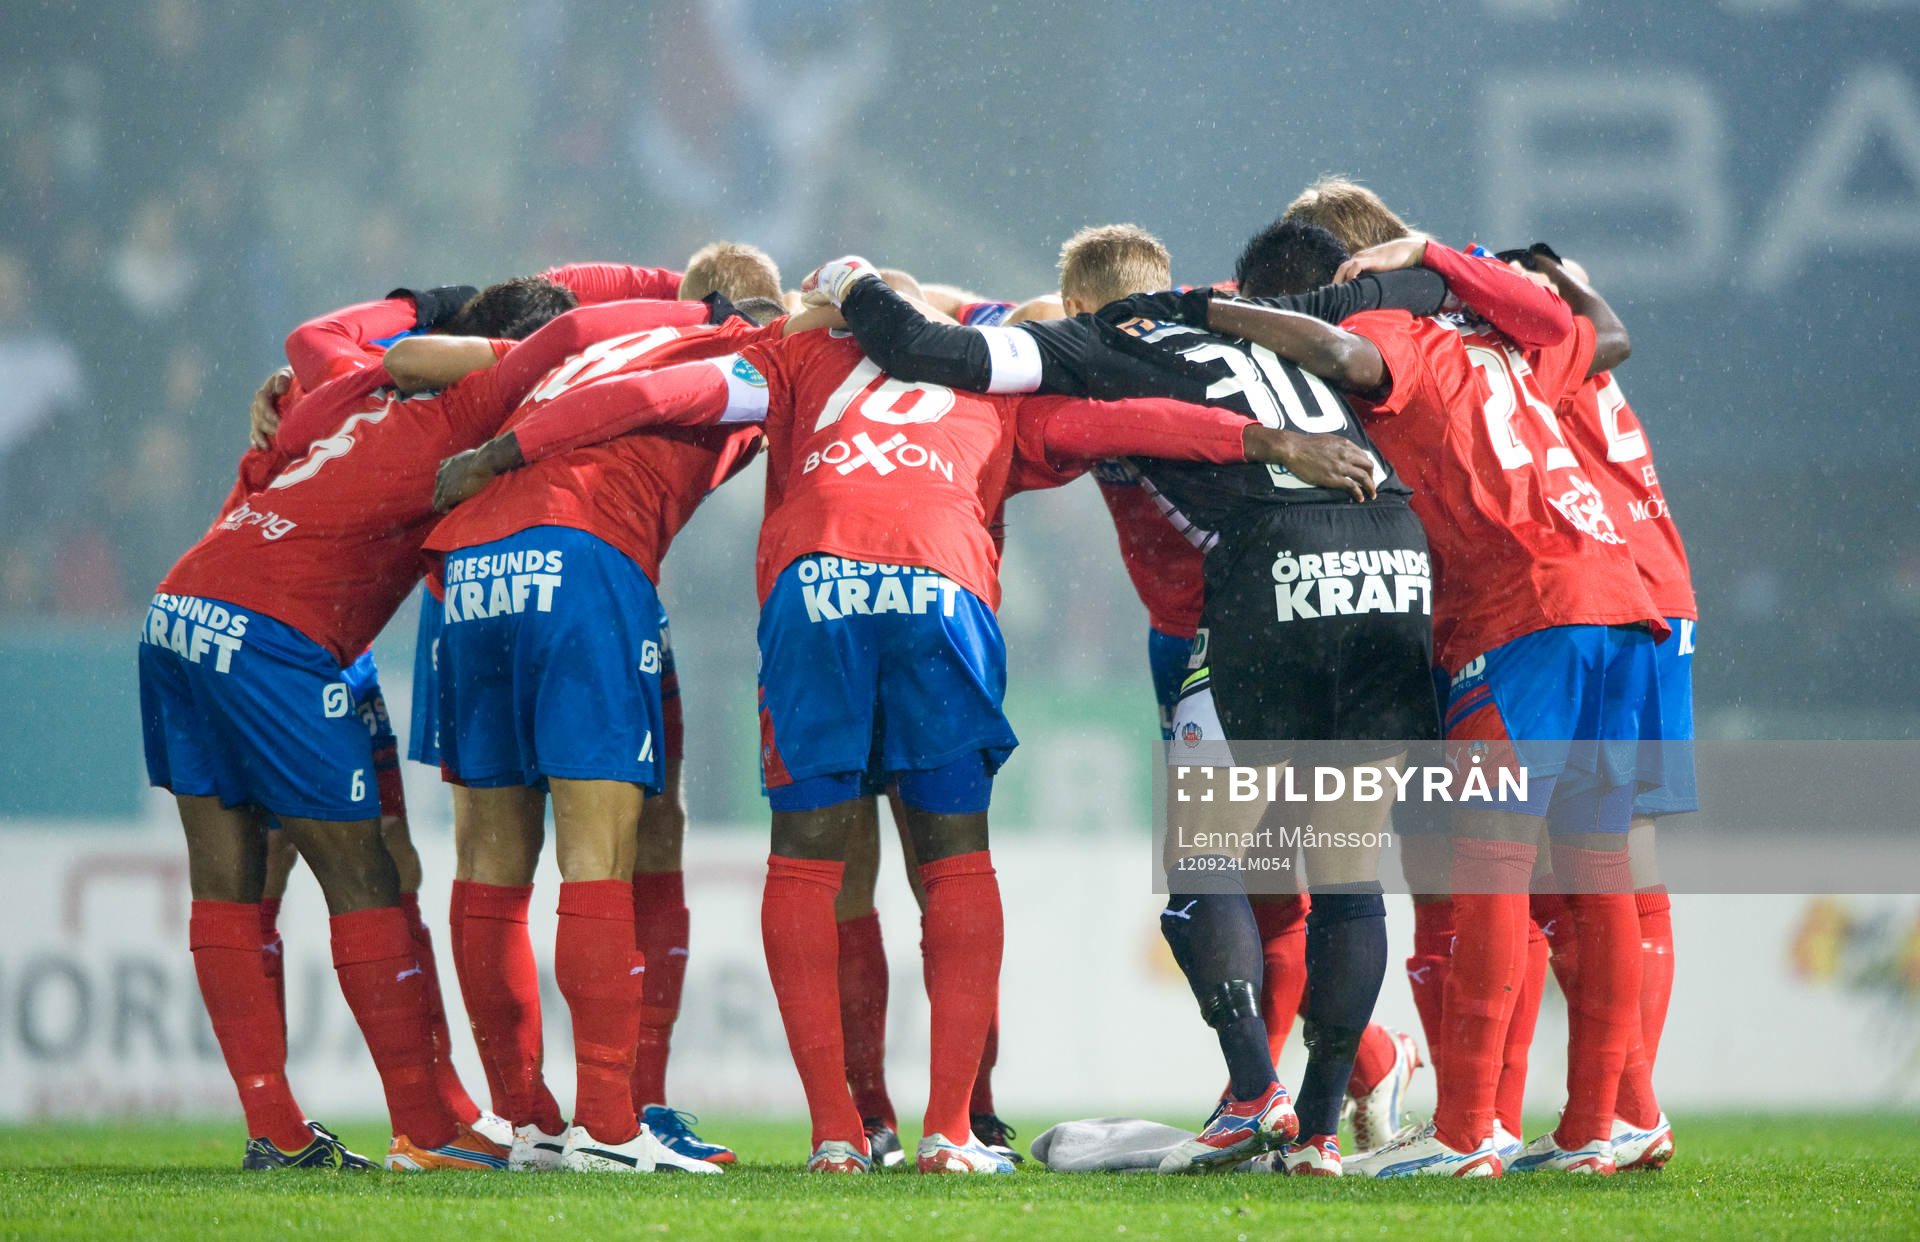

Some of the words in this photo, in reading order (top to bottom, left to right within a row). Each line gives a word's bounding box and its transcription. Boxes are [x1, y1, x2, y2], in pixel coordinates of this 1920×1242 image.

[1175, 342, 1348, 435] 30
[802, 431, 954, 482] BOXON
[447, 550, 563, 585] ÖRESUNDS
[1271, 550, 1430, 583] ÖRESUNDS
[445, 573, 562, 625] KRAFT
[802, 576, 960, 623] KRAFT
[1275, 574, 1431, 622] KRAFT
[350, 768, 366, 802] 6
